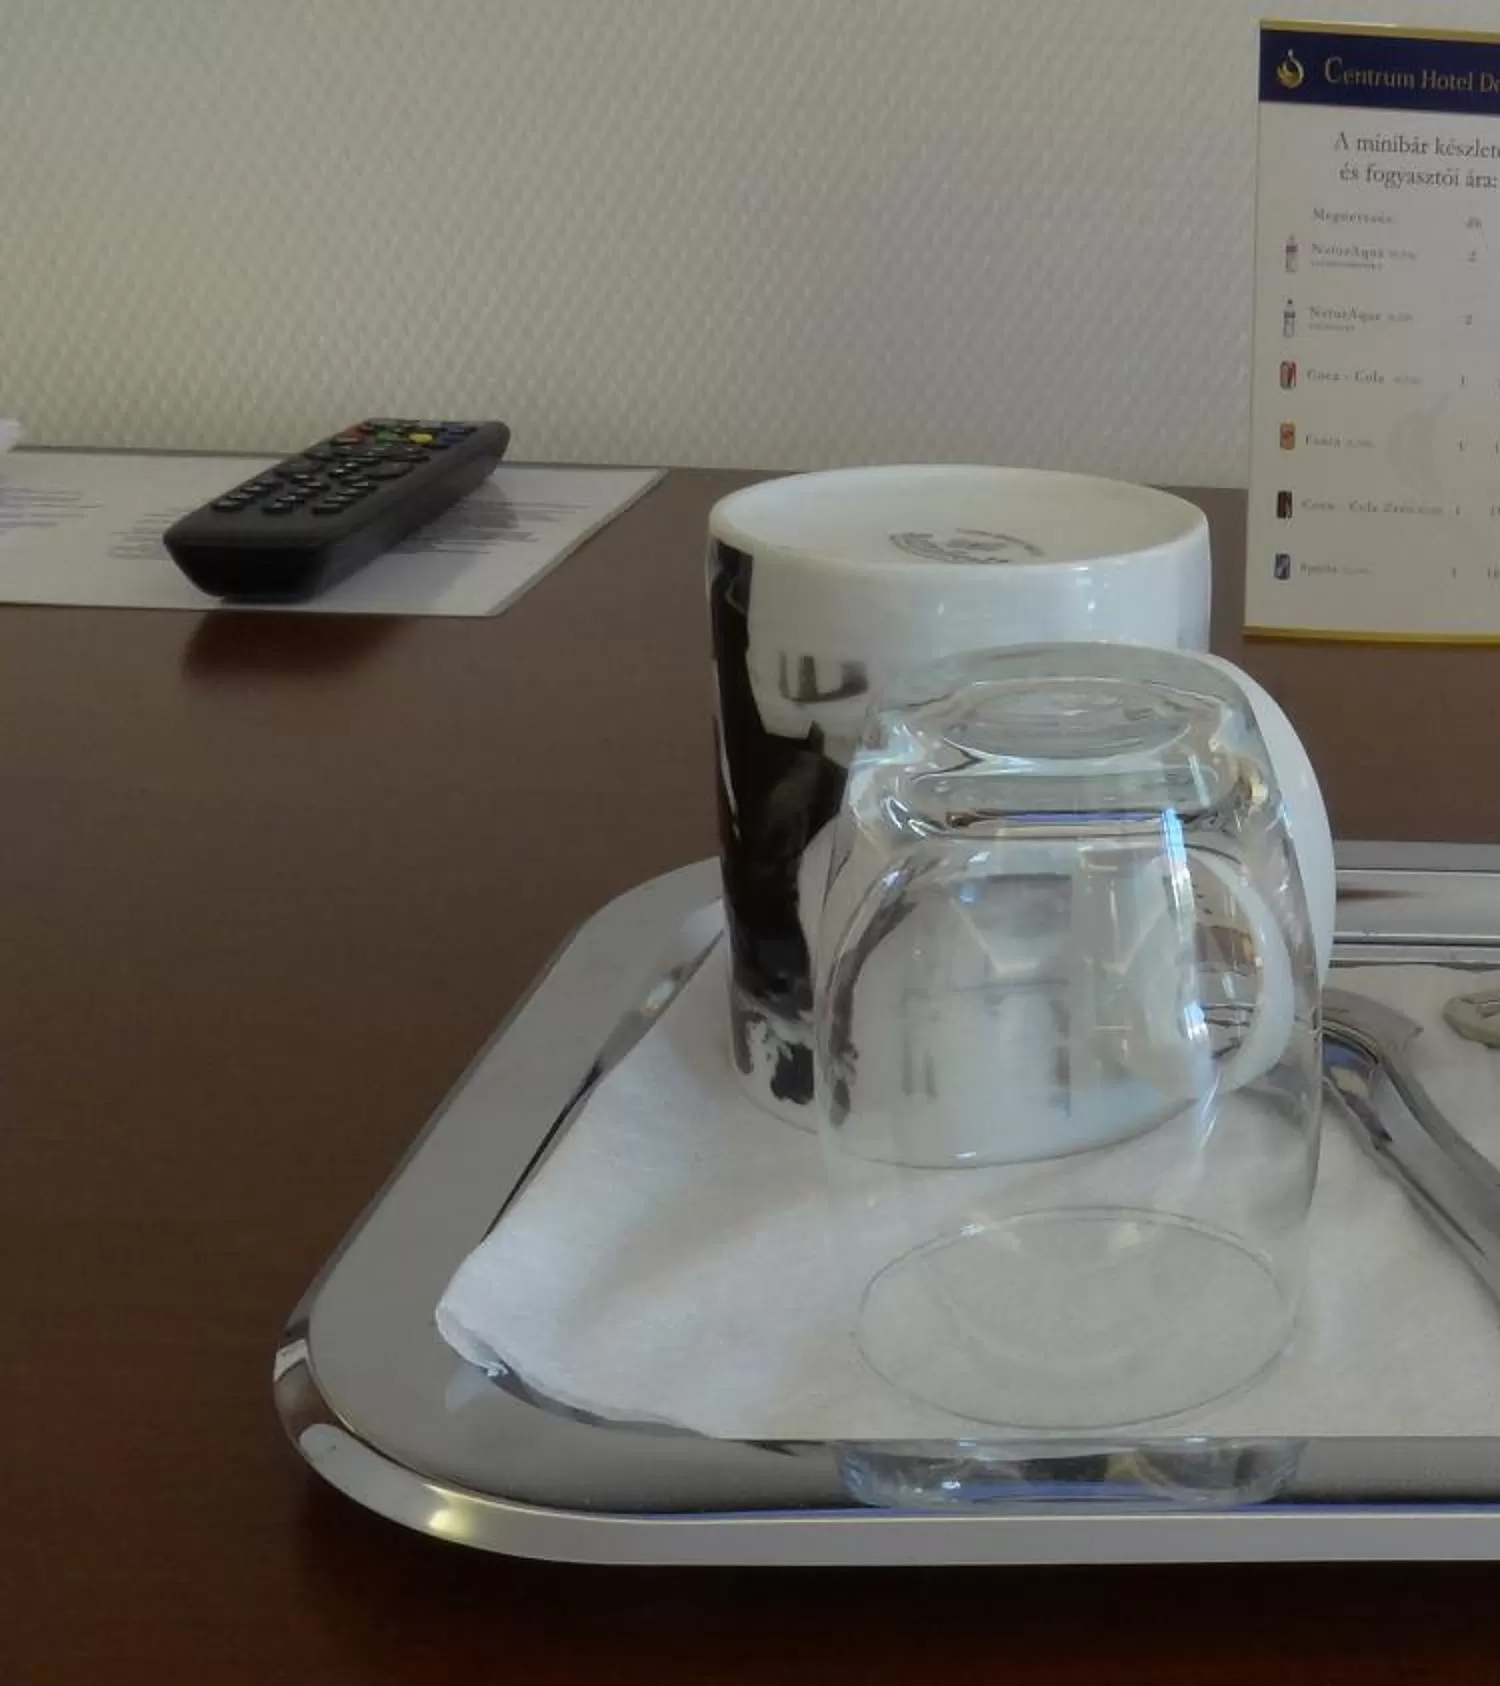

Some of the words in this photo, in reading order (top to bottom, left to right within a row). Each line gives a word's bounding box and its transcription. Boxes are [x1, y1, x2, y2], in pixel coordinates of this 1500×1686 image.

[1324, 56, 1415, 88] Centrum
[1421, 69, 1474, 92] Hotel
[1334, 132, 1349, 151] A
[1356, 135, 1427, 155] minibár
[1339, 163, 1359, 181] és
[1365, 163, 1460, 190] fogyasztói
[1465, 167, 1499, 189] ára:
